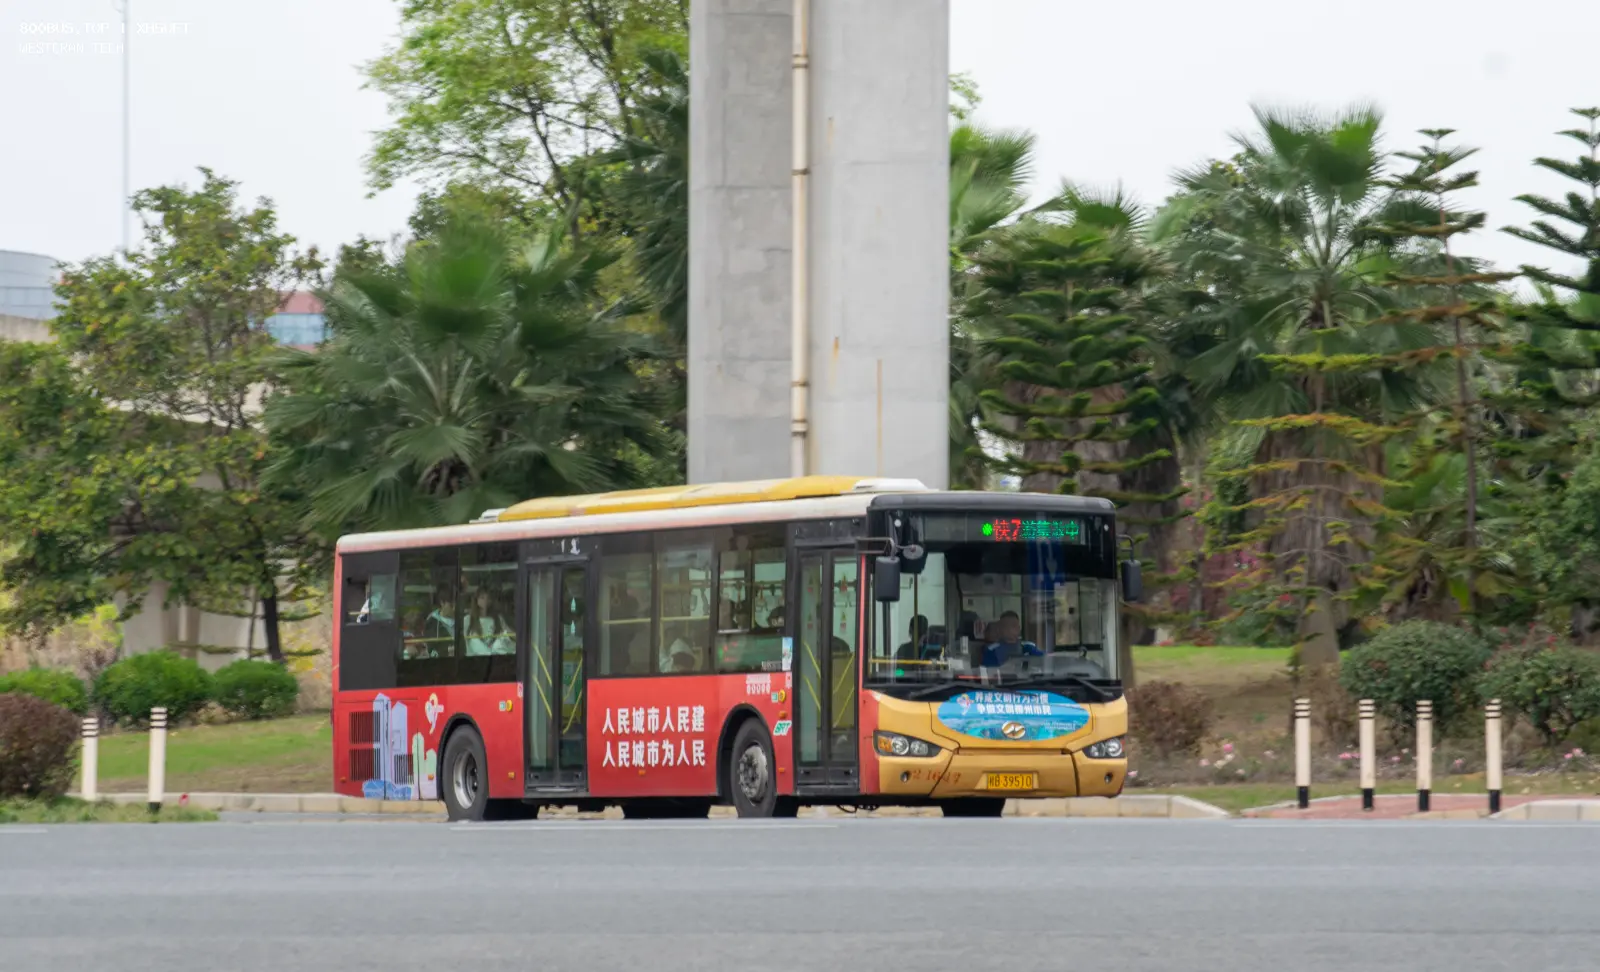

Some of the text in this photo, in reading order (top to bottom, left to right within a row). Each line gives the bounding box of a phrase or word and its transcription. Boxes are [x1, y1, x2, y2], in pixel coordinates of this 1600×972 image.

[602, 705, 705, 734] 人民城市人民建
[602, 738, 706, 768] 人民城市为人民
